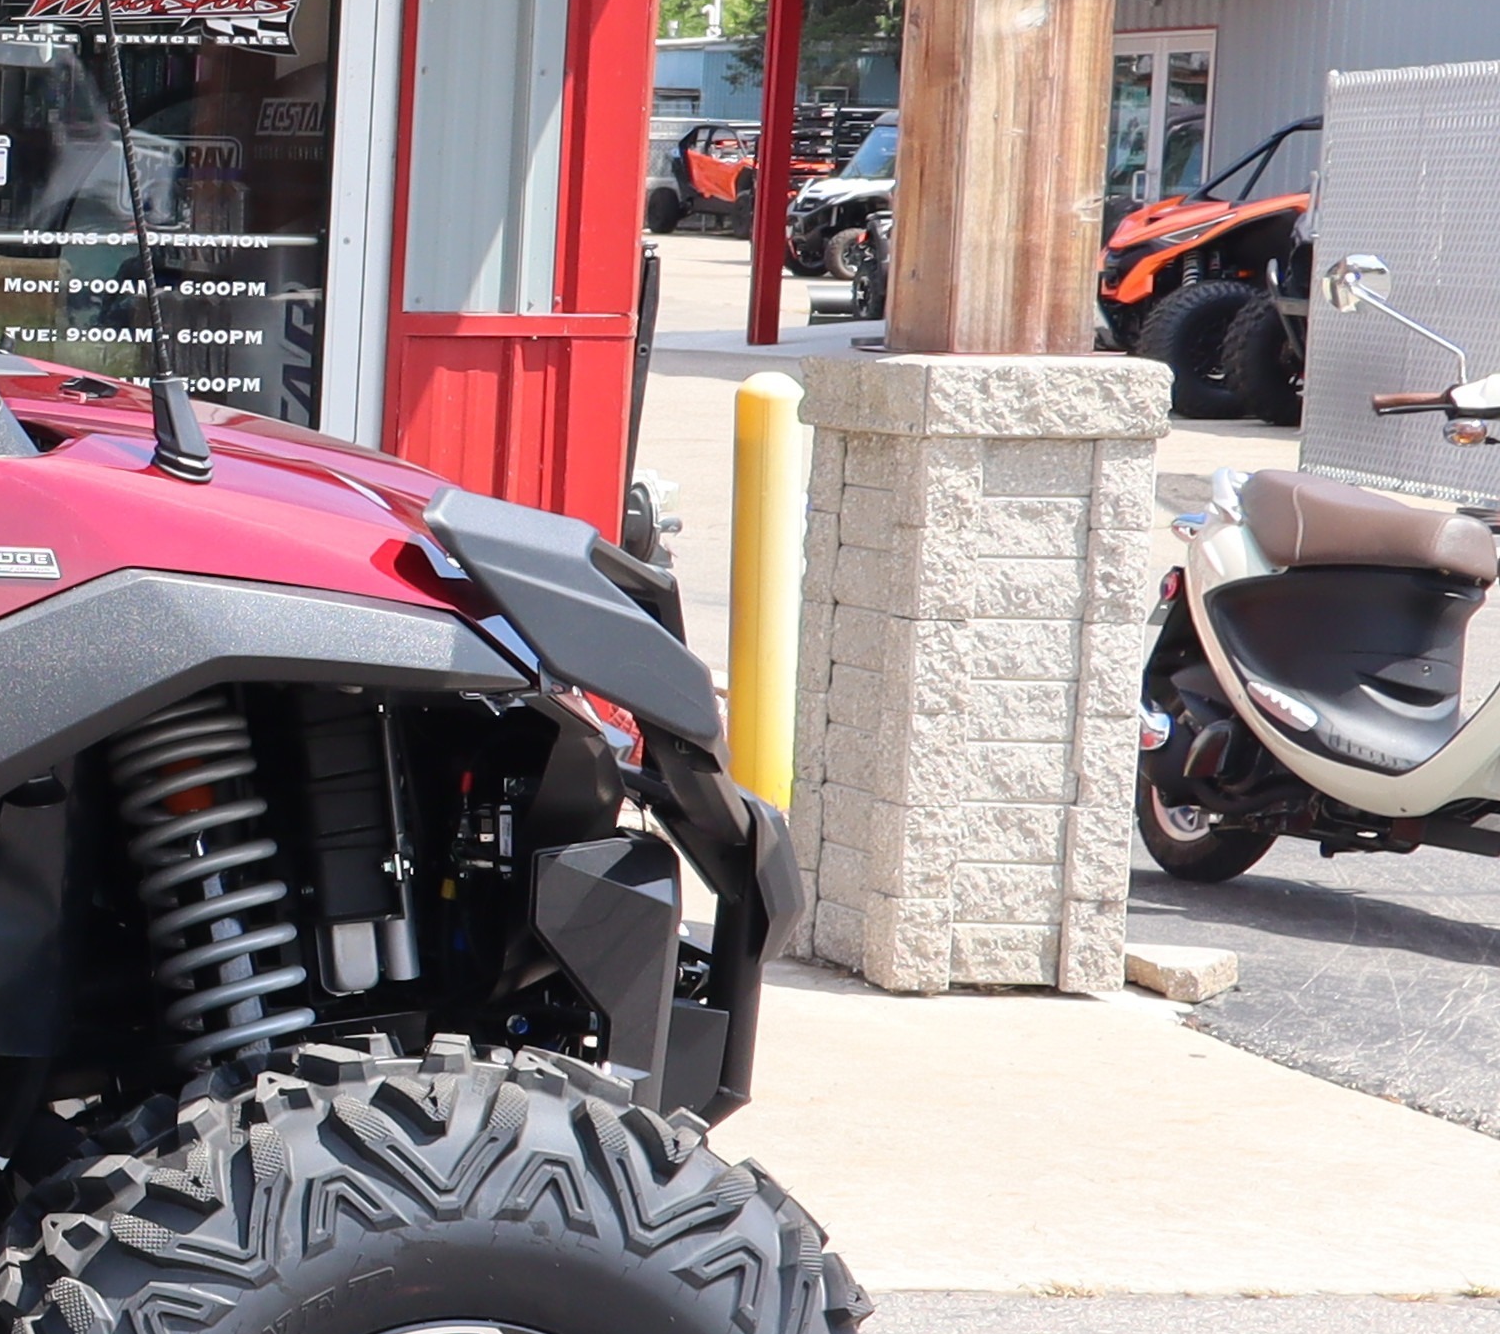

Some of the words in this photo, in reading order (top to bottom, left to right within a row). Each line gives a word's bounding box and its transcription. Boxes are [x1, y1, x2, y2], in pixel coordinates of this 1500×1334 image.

[216, 34, 290, 45] SALES
[179, 281, 267, 297] 6:00PM
[65, 327, 153, 344] 9:00AM
[176, 329, 263, 346] 6:00PM
